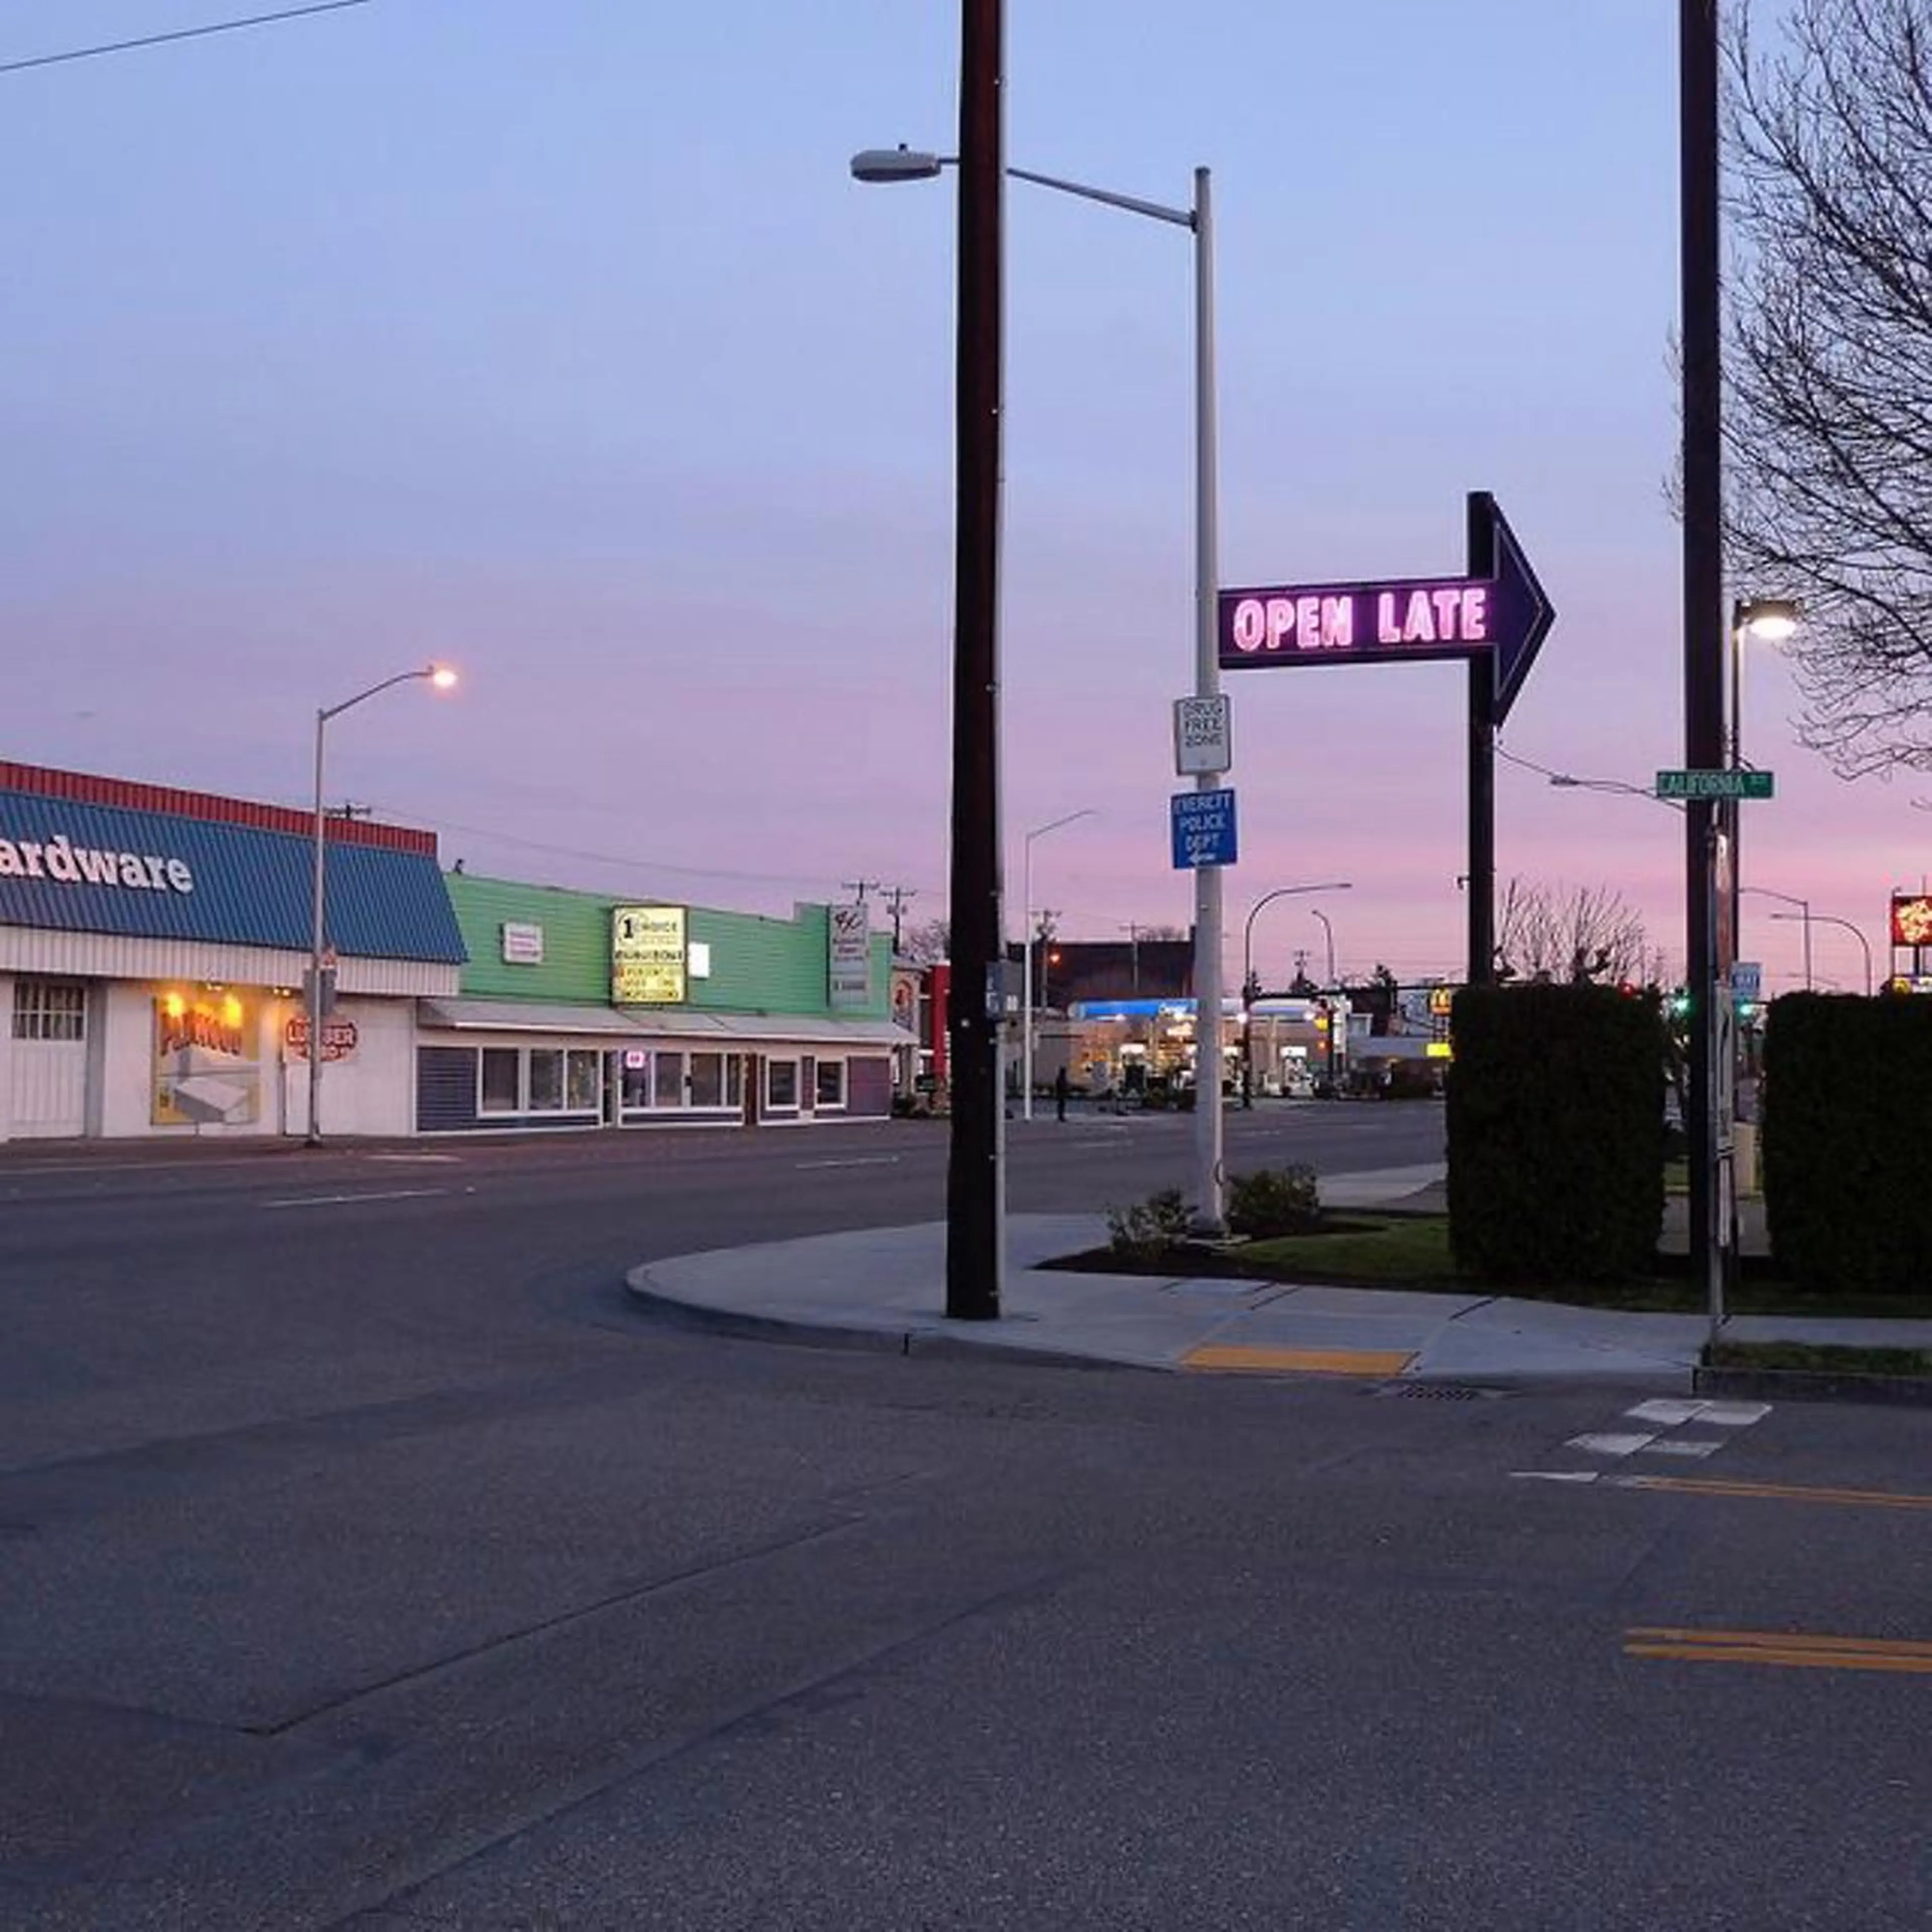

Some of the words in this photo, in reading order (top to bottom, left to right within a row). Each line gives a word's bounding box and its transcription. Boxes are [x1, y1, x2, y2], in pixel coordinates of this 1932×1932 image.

[1233, 597, 1352, 651] OPEN
[1378, 588, 1486, 643] LATE
[1184, 718, 1223, 733] FREE
[1185, 733, 1223, 748] ZONE
[1658, 774, 1745, 794] CALIFORNIA
[1179, 813, 1226, 831] POLICE
[0, 835, 194, 894] ardware
